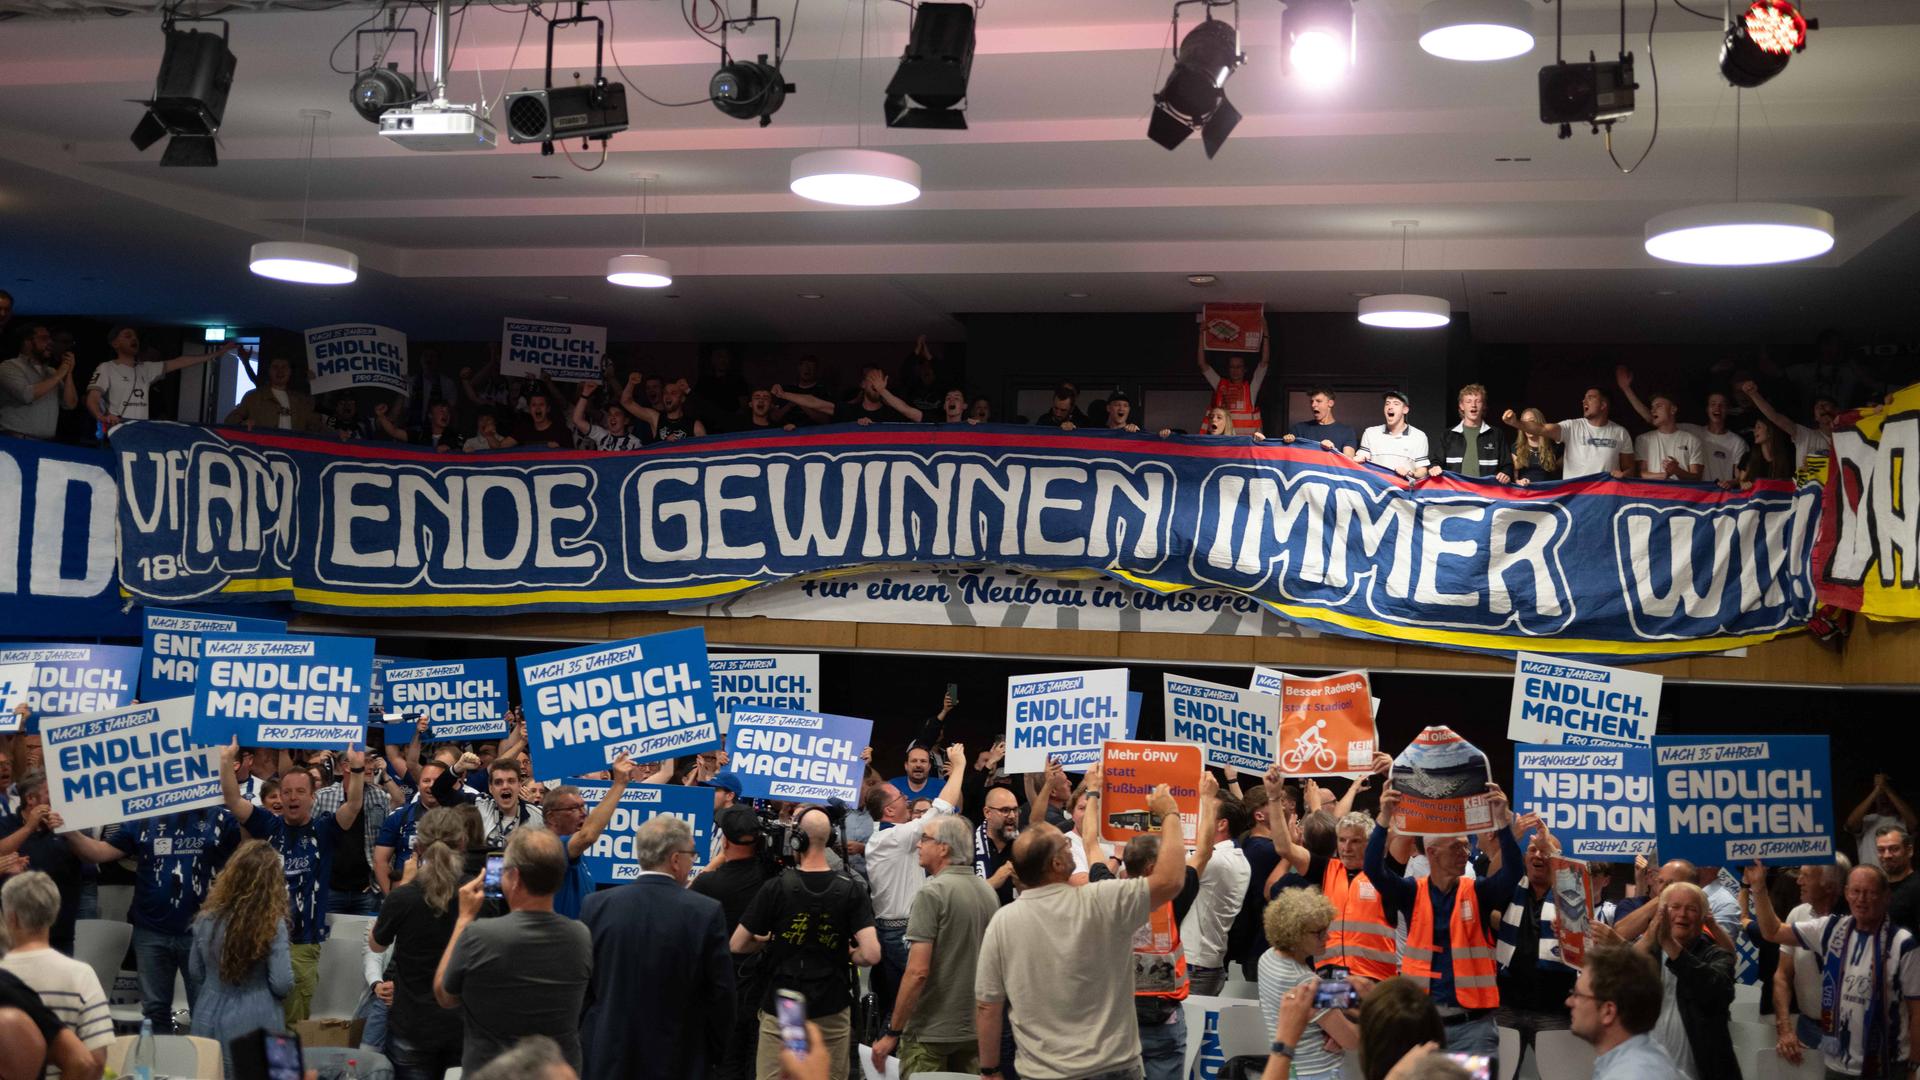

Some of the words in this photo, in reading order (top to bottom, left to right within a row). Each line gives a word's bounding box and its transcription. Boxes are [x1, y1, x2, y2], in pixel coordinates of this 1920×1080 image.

[316, 340, 404, 362] ENDLICH.
[511, 334, 600, 354] ENDLICH.
[509, 348, 599, 370] MACHEN.
[1830, 418, 1920, 580] DA
[197, 451, 293, 553] AM
[331, 472, 598, 570] ENDE
[637, 460, 1166, 560] GEWINNEN
[1206, 474, 1563, 618] IMMER
[866, 577, 951, 603] einen
[958, 575, 1086, 609] Neubau
[1091, 586, 1126, 608] in
[151, 617, 178, 629] NACH
[180, 620, 191, 629] 35
[193, 620, 233, 632] JAHREN
[2, 650, 30, 661] NACH
[31, 651, 44, 660] 35
[45, 650, 87, 660] JAHREN
[208, 642, 243, 655] NACH
[244, 643, 257, 655] 35
[261, 642, 309, 655] JAHREN
[388, 669, 413, 680] NACH
[415, 668, 425, 677] 35
[427, 665, 461, 677] JAHREN
[528, 661, 564, 682] NACH
[567, 659, 582, 674] 35
[586, 646, 637, 671] JAHREN
[709, 660, 727, 670] ACH
[728, 660, 739, 669] 35
[740, 659, 774, 669] JAHREN
[1523, 660, 1550, 675] NACH
[1552, 666, 1564, 677] 35
[1566, 668, 1608, 681] JAHREN
[31, 667, 128, 690] DLICH.
[210, 661, 361, 693] ENDLICH.
[711, 675, 812, 693] ENDLICH.
[1013, 684, 1035, 697] NACH
[1036, 683, 1046, 693] 35
[1047, 678, 1082, 692] JAHREN
[392, 679, 501, 702] ENDLICH.
[537, 662, 702, 716] ENDLICH.
[1169, 683, 1192, 694] NACH
[1193, 687, 1204, 697] 35
[1204, 688, 1237, 701] JAHREN
[1285, 685, 1323, 697] Besser
[1324, 681, 1363, 695] Radwege
[1525, 677, 1649, 717] ENDLICH.
[206, 691, 358, 723] MACHEN.
[1016, 696, 1118, 723] ENDLICH.
[1173, 697, 1273, 736] ENDLICH.
[51, 725, 86, 743] NACH
[88, 722, 103, 736] 35
[104, 710, 155, 731] JAHREN
[436, 725, 454, 736] PRO
[455, 723, 503, 735] STADIONBAU
[541, 695, 707, 749] MACHEN.
[737, 713, 764, 723] NACH
[766, 716, 777, 724] 35
[779, 716, 819, 727] JAHREN
[1522, 700, 1645, 740] MACHEN.
[263, 726, 288, 739] PRO
[291, 726, 359, 740] STADIONBAU
[640, 727, 711, 754] STADIONBAU
[1014, 722, 1117, 749] MACHEN
[1174, 719, 1273, 758] MACHEN.
[736, 728, 858, 762] ENDLICH.
[1107, 749, 1140, 761] Mehr
[1142, 748, 1178, 762] ÖPNV
[1661, 747, 1696, 763] NACH
[1697, 746, 1712, 760] 35
[1715, 743, 1765, 760] JAHREN
[1069, 750, 1102, 764] STADION
[1211, 751, 1229, 762] PRO
[1230, 755, 1270, 770] STADIONBA
[1522, 755, 1591, 767] STADIONBAU
[1592, 755, 1617, 766] PRO
[62, 754, 219, 803] MACHEN.
[730, 751, 854, 786] MACHEN.
[1106, 767, 1135, 777] statt
[774, 783, 795, 793] PRO
[1524, 771, 1655, 803] ACHEN.
[1667, 769, 1822, 800] ENDLICH.
[127, 797, 153, 814] PRO
[155, 782, 221, 807] STADIONBAU
[620, 791, 658, 801] AHREN
[1179, 812, 1198, 823] EIN
[1524, 802, 1656, 834] NDLICH.
[1668, 803, 1825, 835] MACHEN.
[1577, 840, 1627, 853] JAHREN
[1631, 842, 1645, 853] 35
[1731, 842, 1756, 857] PRO
[1760, 839, 1828, 856] STADIONBAU
[617, 866, 639, 877] PRO
